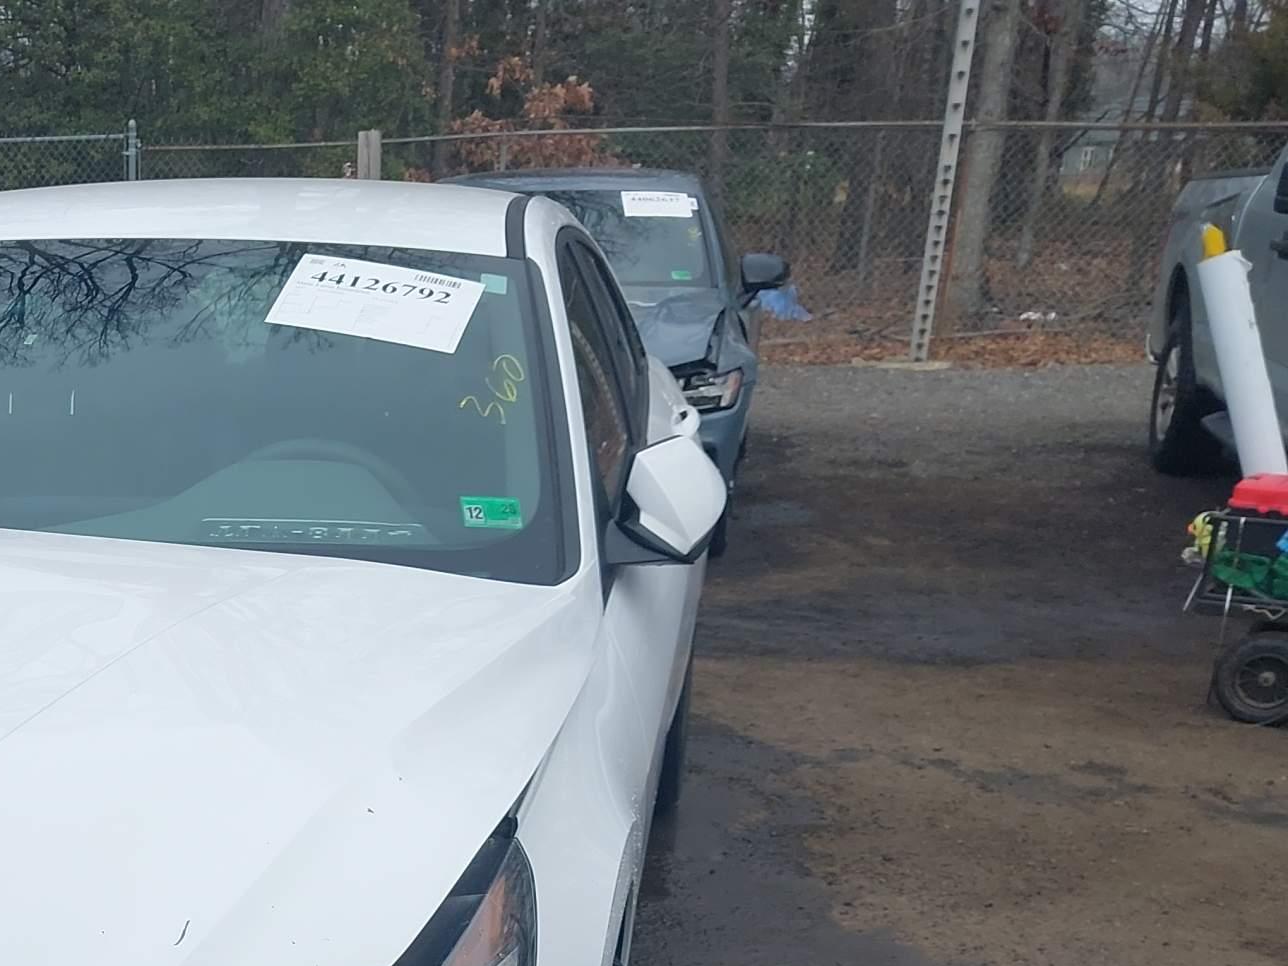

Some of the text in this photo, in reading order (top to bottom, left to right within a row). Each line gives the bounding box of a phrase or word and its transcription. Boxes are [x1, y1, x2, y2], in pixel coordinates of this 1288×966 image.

[311, 270, 451, 304] 44126792
[459, 354, 525, 425] 360
[465, 505, 484, 520] 12
